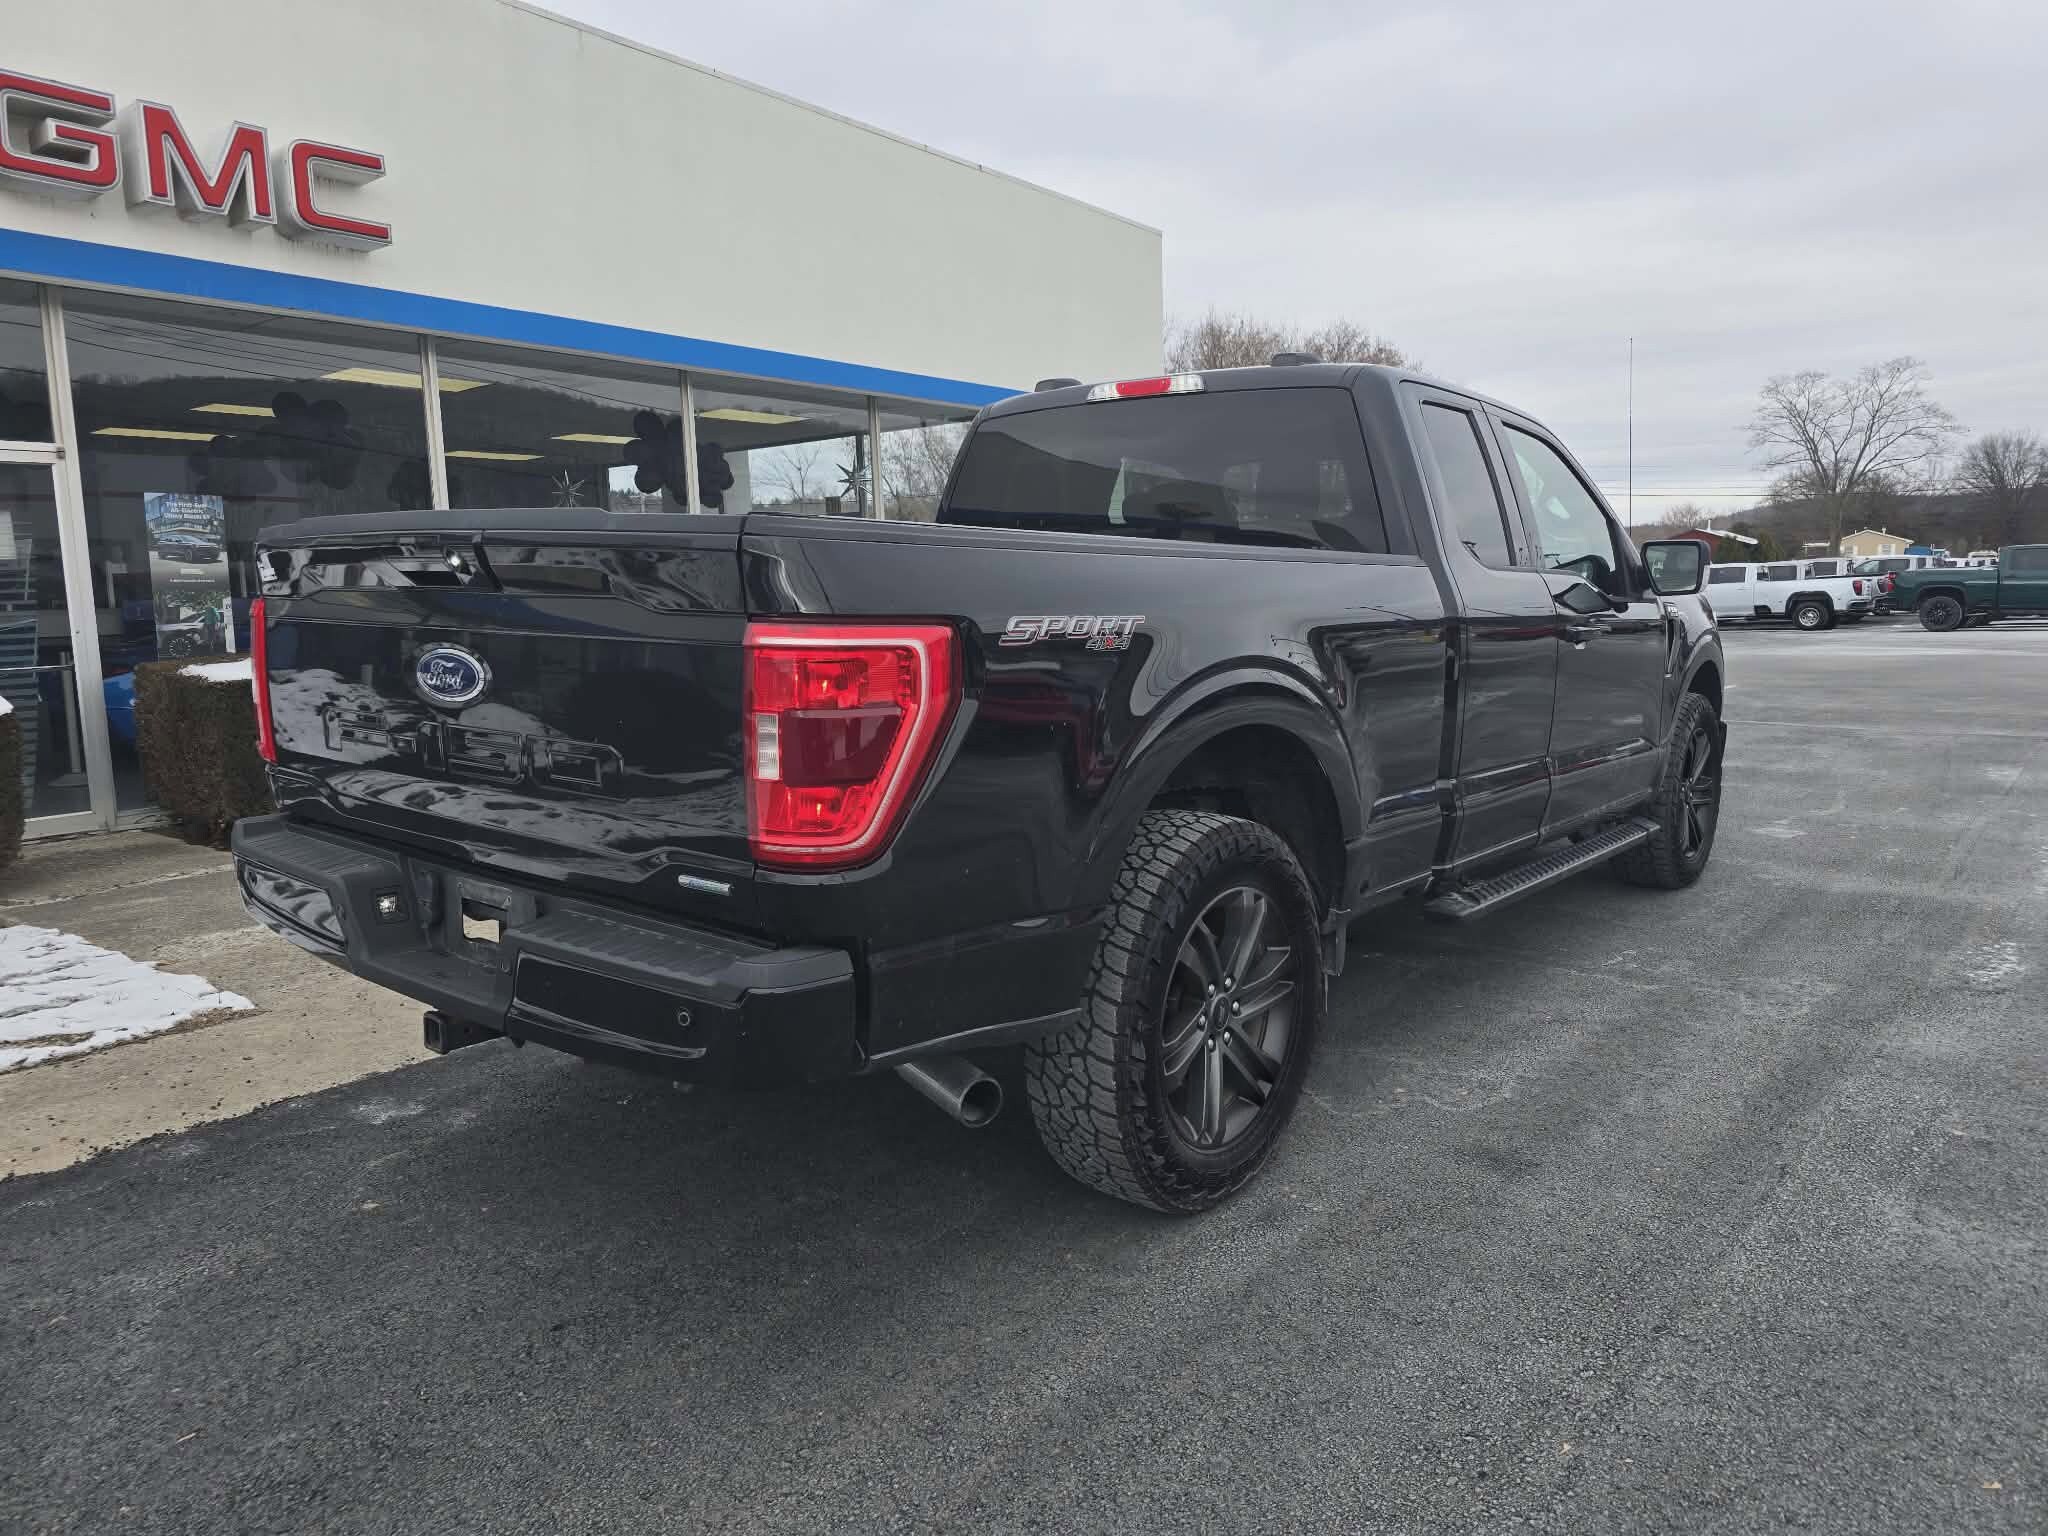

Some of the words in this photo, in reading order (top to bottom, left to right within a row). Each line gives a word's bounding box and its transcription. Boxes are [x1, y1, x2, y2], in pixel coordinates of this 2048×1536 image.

[0, 68, 392, 248] GMC
[999, 615, 1145, 646] SPORT
[425, 659, 465, 690] Ford
